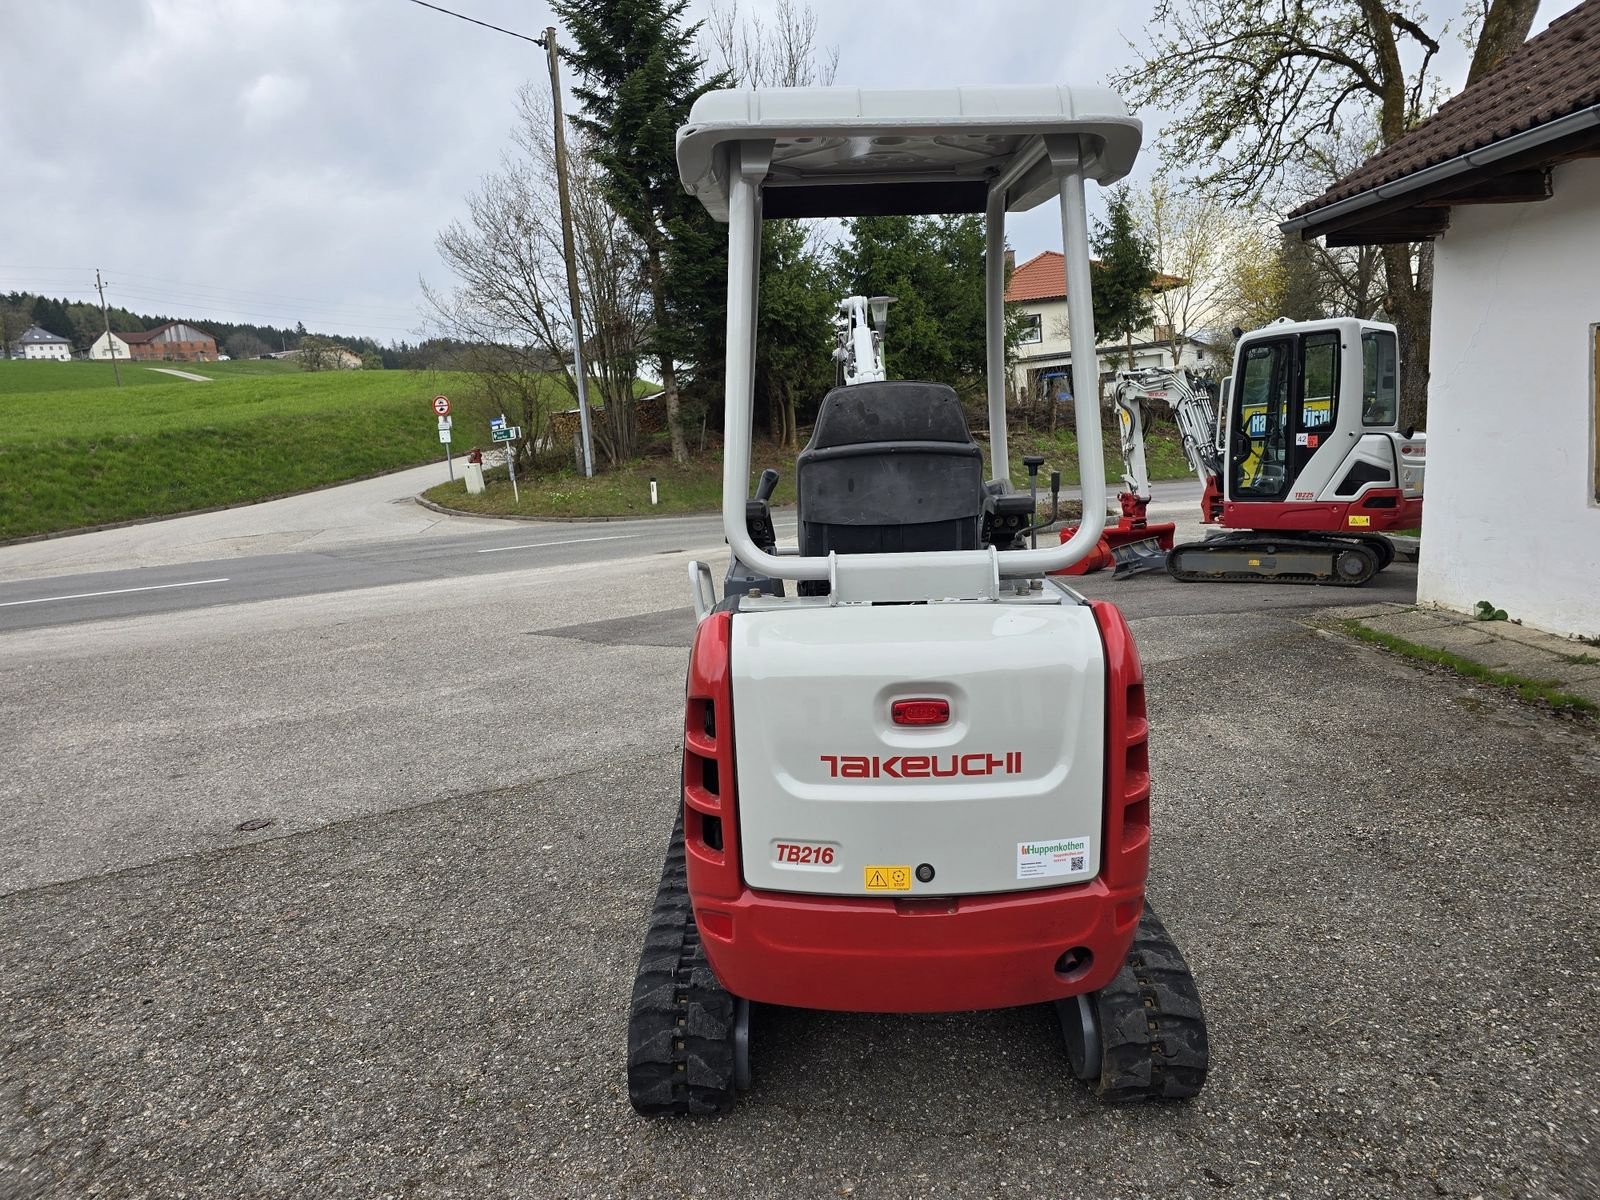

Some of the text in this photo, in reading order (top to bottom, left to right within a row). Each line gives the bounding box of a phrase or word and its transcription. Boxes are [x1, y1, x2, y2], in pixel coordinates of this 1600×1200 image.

[1297, 435, 1306, 443] 42
[820, 751, 1022, 778] TAKEUCHI
[776, 844, 834, 865] TB216
[1027, 841, 1085, 856] Huppenkothen
